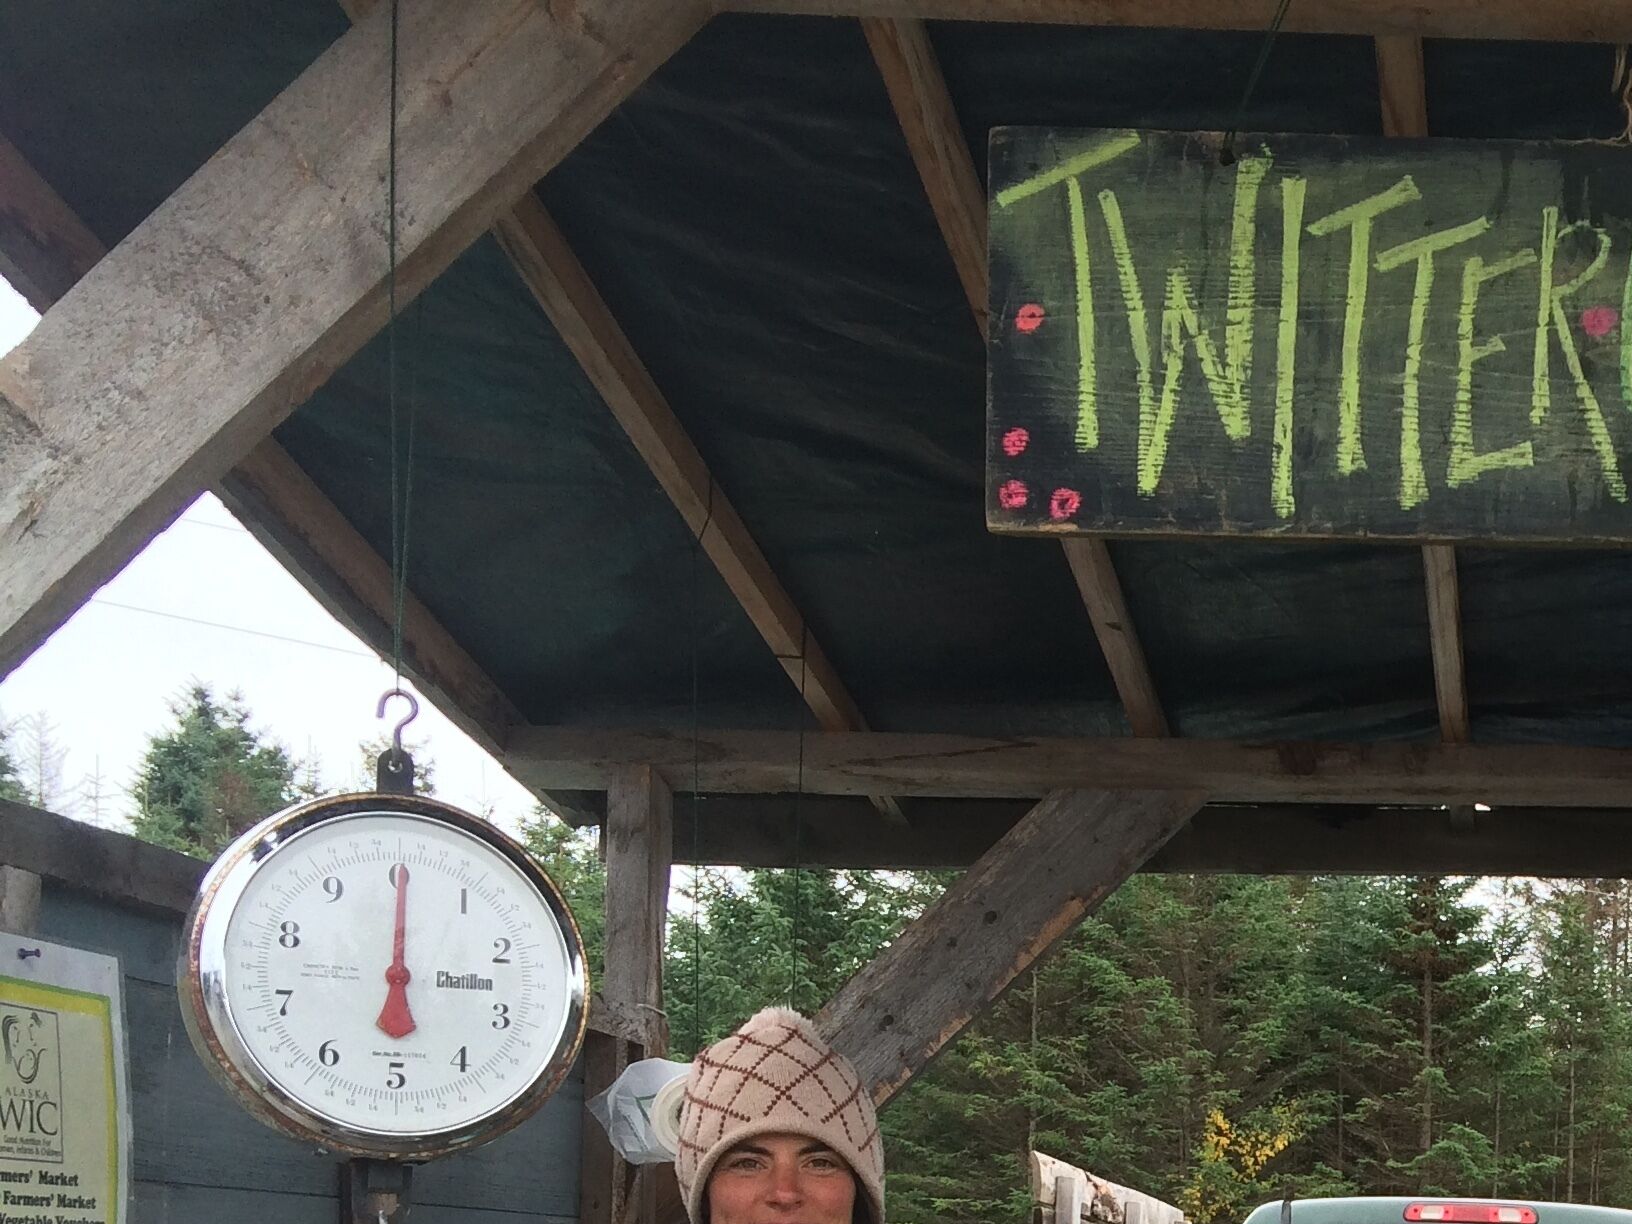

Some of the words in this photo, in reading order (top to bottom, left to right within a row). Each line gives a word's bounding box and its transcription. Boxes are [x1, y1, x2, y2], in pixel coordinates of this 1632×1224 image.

[995, 131, 1628, 519] TWITTER
[322, 876, 344, 903] 9
[460, 888, 467, 914] 1
[279, 920, 301, 948] 8
[492, 937, 511, 964] 2
[436, 971, 493, 991] Chatillon
[275, 989, 294, 1016] 7
[492, 1003, 511, 1030] 3
[318, 1040, 340, 1067] 6
[450, 1046, 471, 1073] 4
[386, 1062, 406, 1089] 5
[5, 1086, 49, 1100] ALASKA
[0, 1097, 58, 1136] WIC
[0, 1169, 33, 1183] mers'
[39, 1170, 78, 1187] Market
[3, 1190, 54, 1207] Farmers'
[56, 1194, 96, 1210] Market
